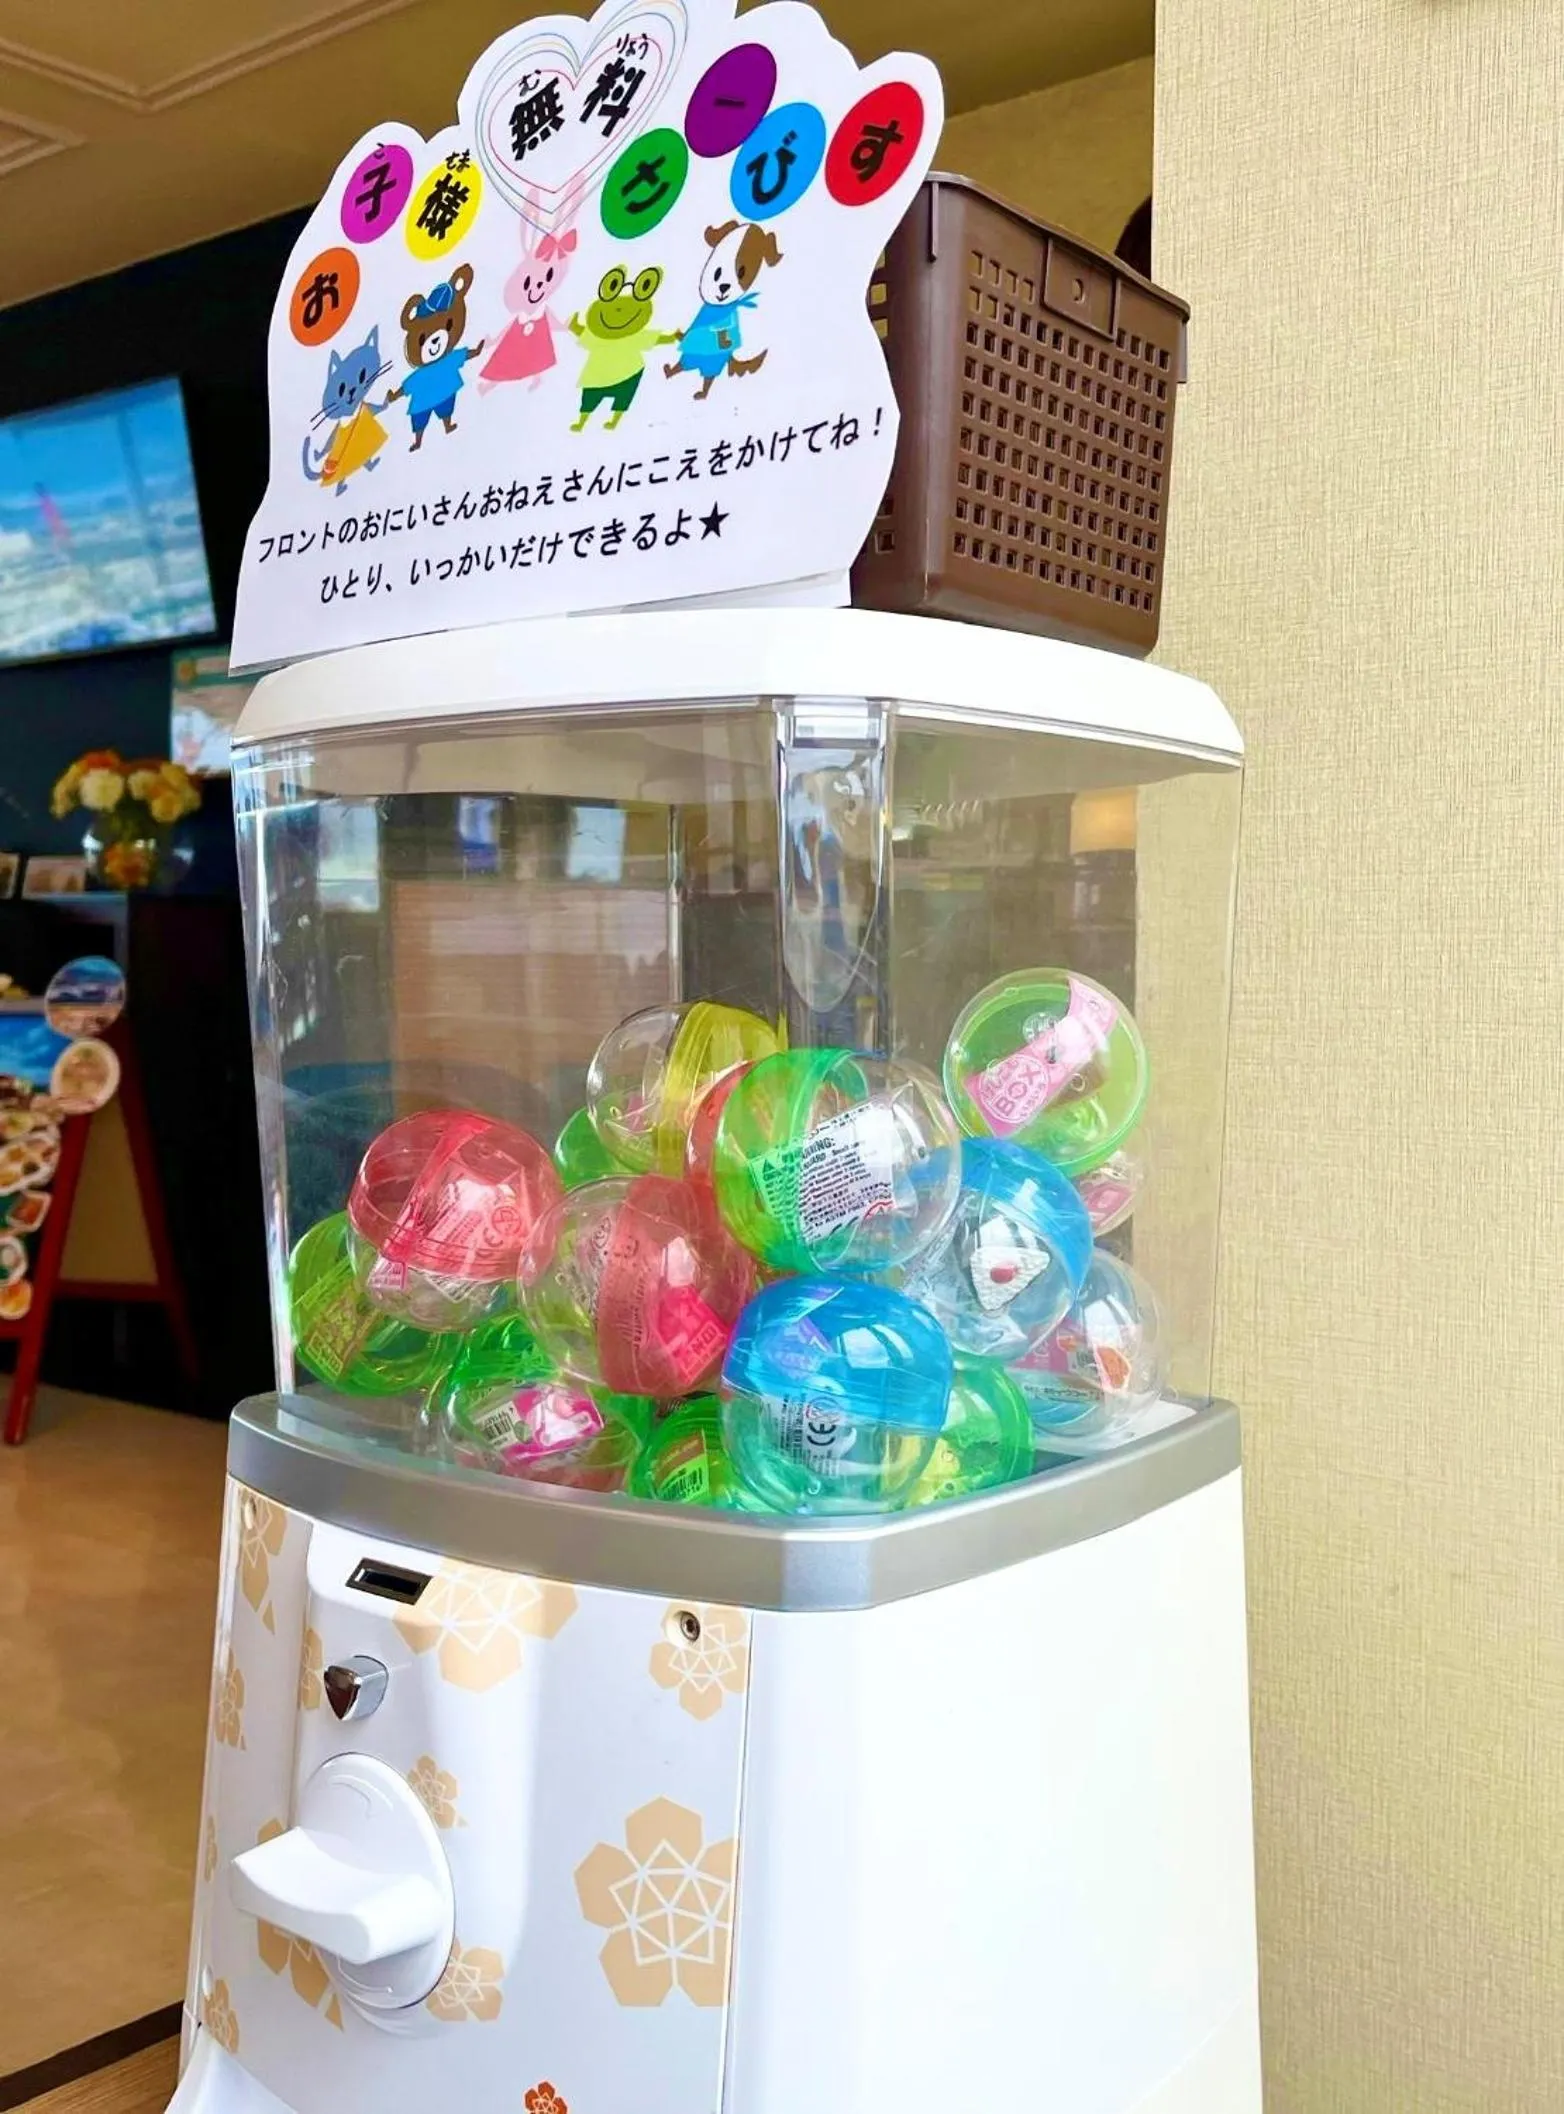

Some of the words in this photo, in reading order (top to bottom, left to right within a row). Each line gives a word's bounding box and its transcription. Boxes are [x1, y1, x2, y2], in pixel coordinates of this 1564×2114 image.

[258, 407, 883, 563] フロントのおにいさんおねえさんにこえをかけてね！
